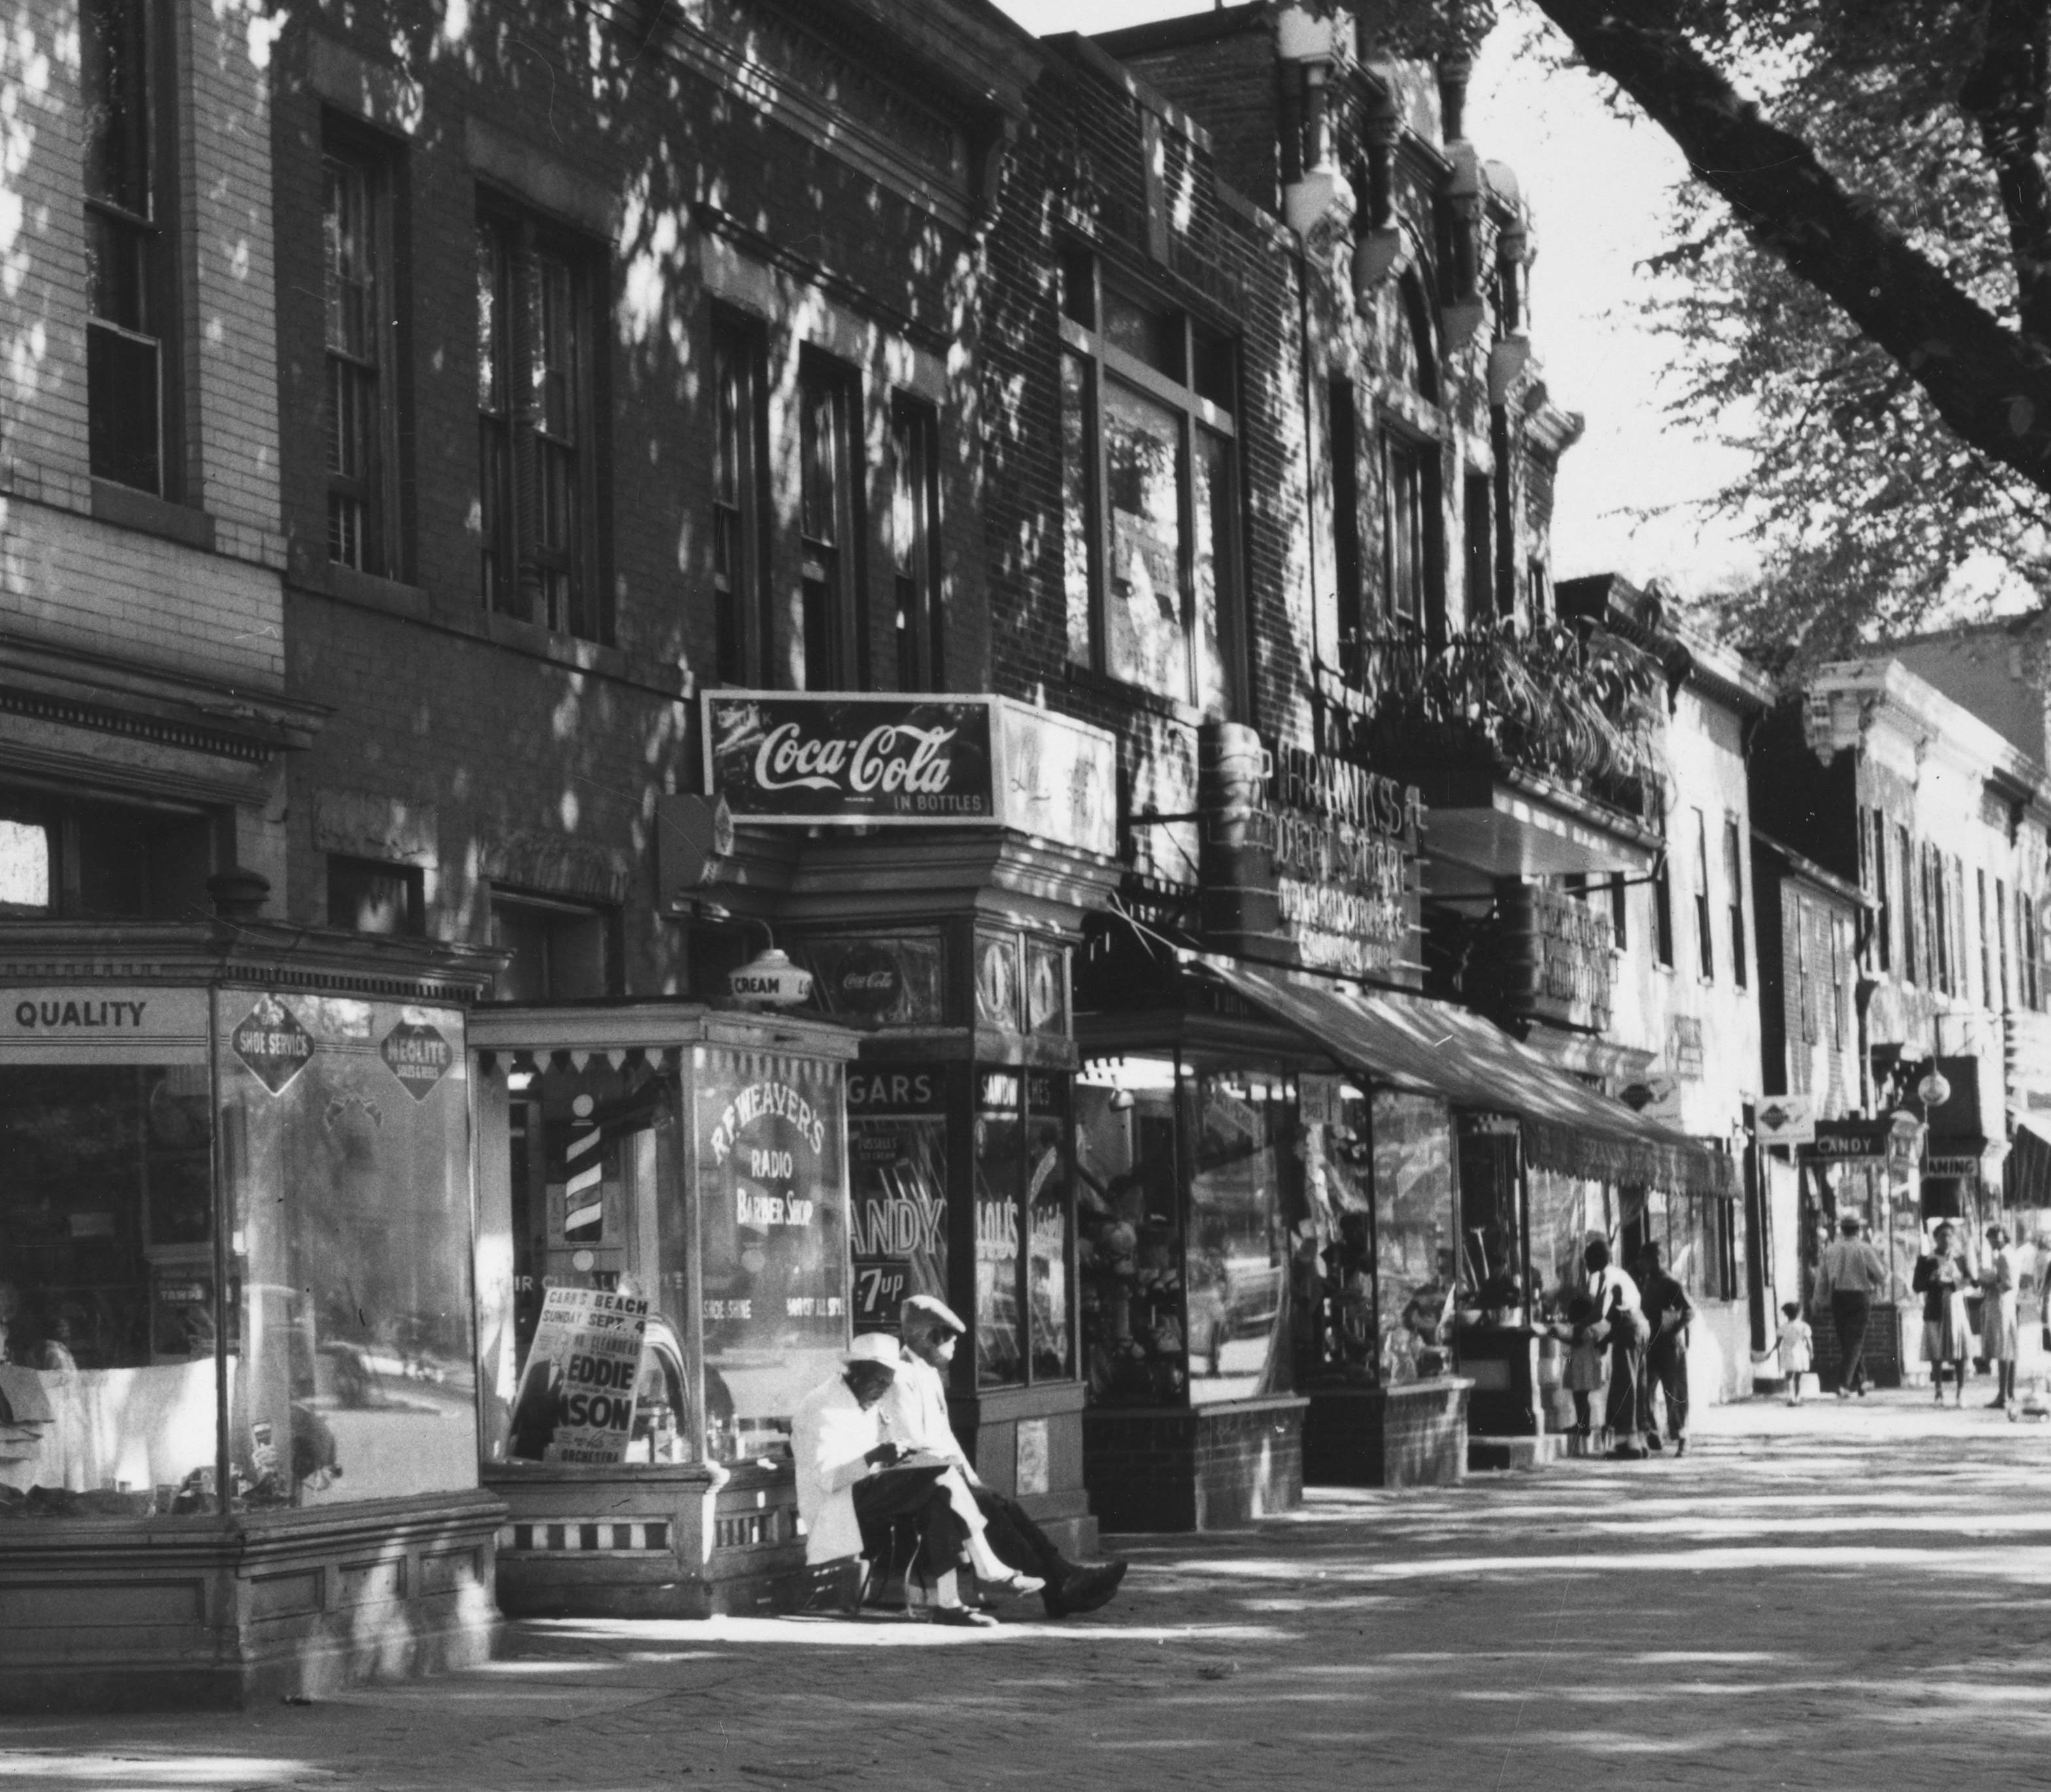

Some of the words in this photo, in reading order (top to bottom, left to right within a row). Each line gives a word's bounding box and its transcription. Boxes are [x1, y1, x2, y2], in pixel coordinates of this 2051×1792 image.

[754, 722, 958, 793] Coca-Cola
[894, 795, 911, 811] IN
[917, 795, 981, 811] BOTTLES
[735, 978, 779, 994] CREAM
[15, 1001, 146, 1027] QUALITY
[240, 1031, 265, 1054] SHOE
[269, 1032, 308, 1057] SERVICE
[734, 1082, 826, 1155] WEAVER'S
[1817, 1136, 1872, 1153] CANDY
[751, 1149, 793, 1179] RADIO
[594, 1294, 649, 1315] BEACH
[542, 1310, 583, 1324] SUNDAY
[588, 1313, 627, 1332] SEPT.
[634, 1320, 645, 1334] 4
[568, 1353, 636, 1390] EDDIE
